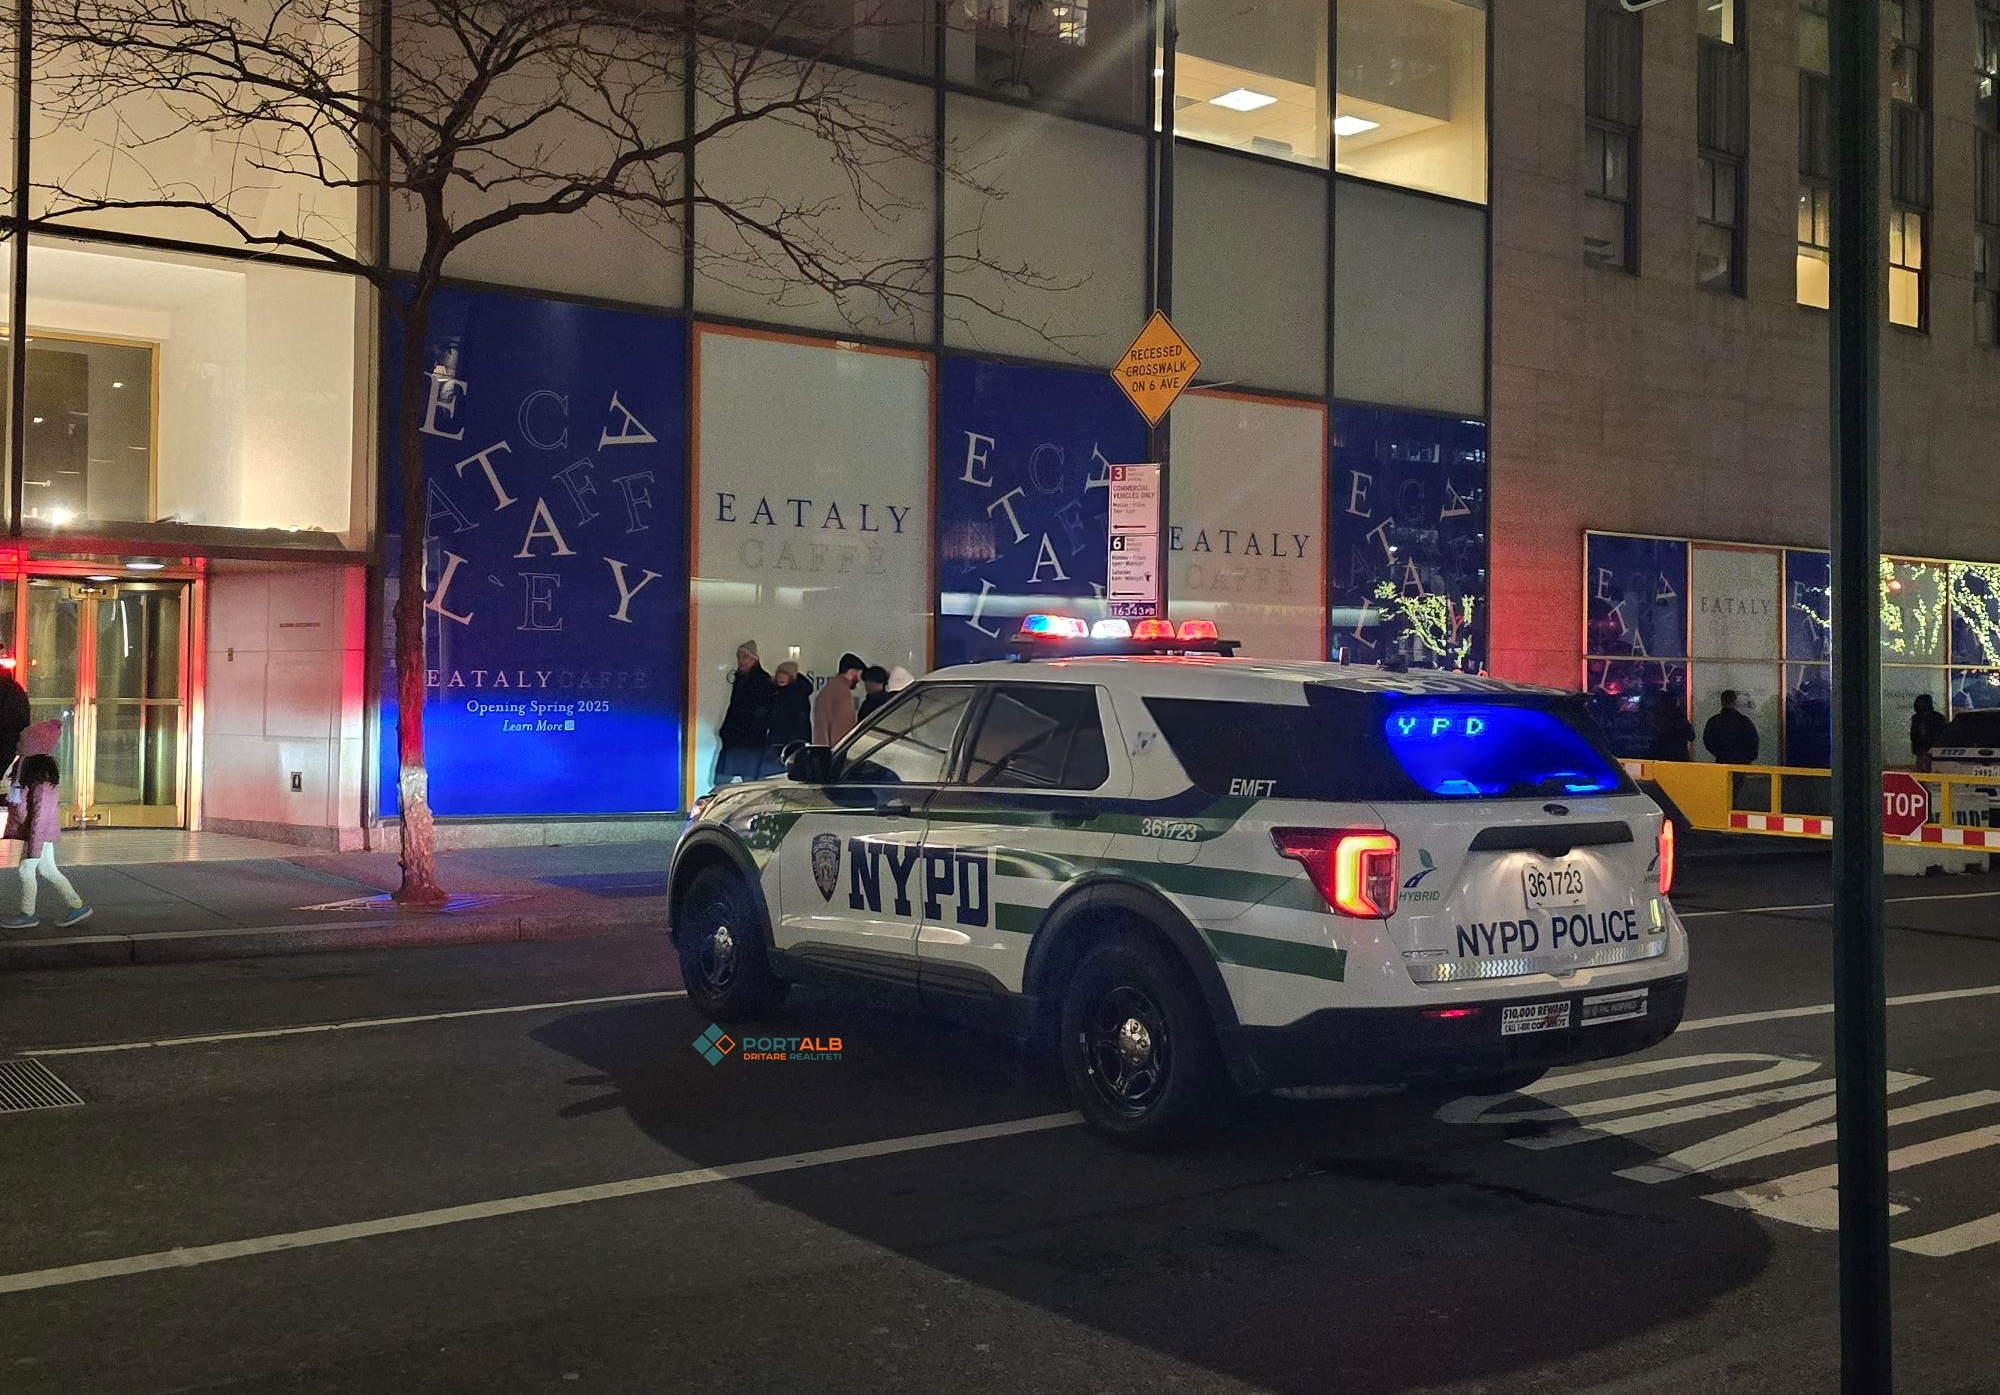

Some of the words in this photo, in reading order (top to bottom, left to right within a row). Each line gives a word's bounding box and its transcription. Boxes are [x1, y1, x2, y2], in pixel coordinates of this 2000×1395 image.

[1131, 345, 1182, 361] RECESSED
[1126, 361, 1187, 377] CROSSWALK
[1132, 381, 1145, 392] ON
[1149, 380, 1155, 390] 6
[1160, 377, 1180, 389] AVE
[1114, 467, 1123, 480] 3
[716, 493, 911, 533] EATALY
[1113, 537, 1122, 550] 6
[1169, 526, 1310, 558] EATALY
[1701, 596, 1771, 616] EATALY
[426, 669, 552, 688] EATALY
[467, 700, 525, 716] Opening
[530, 700, 574, 716] Spring
[578, 701, 609, 713] 2025
[502, 720, 532, 732] Learn
[536, 720, 563, 732] More
[1229, 778, 1277, 797] EMFT
[1884, 792, 1924, 817] TOP
[1141, 818, 1197, 840] 361723
[848, 837, 989, 928] NYPD
[1528, 869, 1583, 898] 361723
[1399, 891, 1440, 902] HYBRID
[1456, 919, 1539, 957] NYPD
[1552, 910, 1638, 948] POLICE
[1504, 1006, 1536, 1020] $10,000
